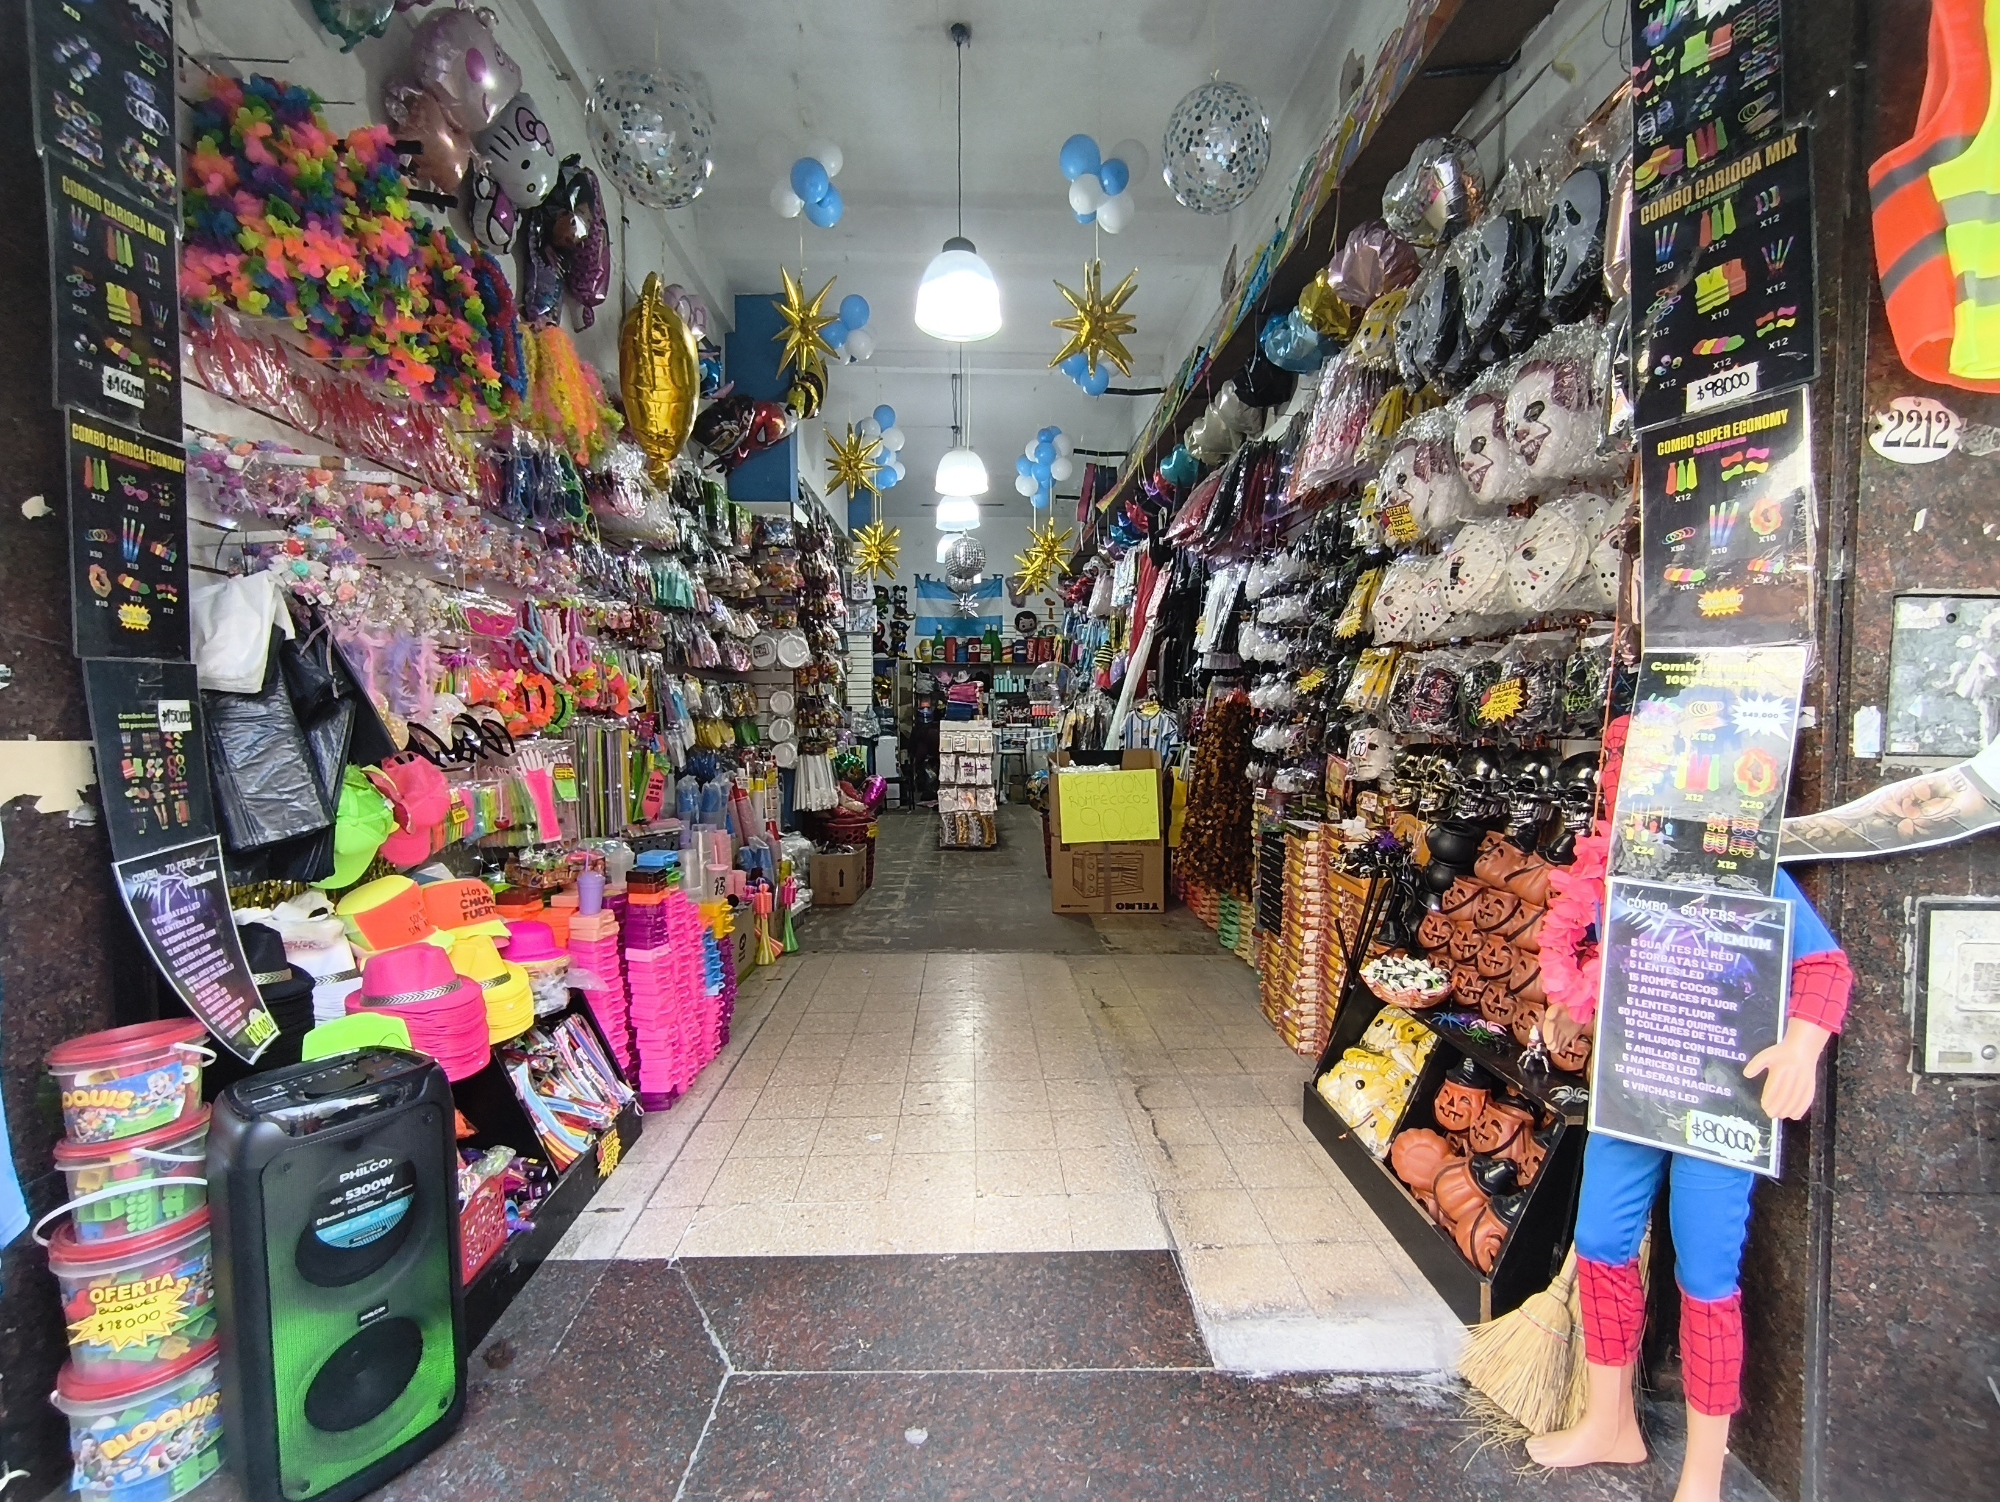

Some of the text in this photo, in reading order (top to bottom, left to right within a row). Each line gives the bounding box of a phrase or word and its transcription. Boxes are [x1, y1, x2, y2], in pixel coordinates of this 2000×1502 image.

[1640, 133, 1798, 226] COMBO CARIOCA MIX
[62, 175, 166, 246] COMBO CARIOCA MIX
[1760, 214, 1780, 228] X12
[1708, 240, 1727, 253] X12
[1655, 262, 1674, 275] X20
[1766, 282, 1786, 296] X12
[1710, 308, 1730, 321] X10
[1652, 328, 1670, 340] X12
[1768, 338, 1788, 350] X12
[1712, 358, 1732, 370] X12
[1659, 378, 1676, 390] X12
[1658, 434, 1694, 456] COMBO
[1696, 424, 1731, 446] SUPER
[1733, 408, 1788, 437] ECONOMY
[1883, 409, 1951, 449] 2212
[72, 423, 186, 474] COMBO CARIOCA ECONOMY
[1675, 493, 1692, 502] X12
[1386, 505, 1410, 516] OFERTA
[1758, 534, 1776, 543] X10
[1712, 546, 1728, 555] X10
[1490, 678, 1520, 694] OFERTA
[1666, 675, 1688, 685] 100
[1740, 800, 1764, 810] X20
[1632, 846, 1654, 856] X24
[1718, 860, 1737, 870] X12
[132, 868, 158, 884] COMBO
[462, 906, 496, 920] FUERT
[1627, 898, 1736, 922] COMBO 60 PERS
[1640, 939, 1691, 955] GUANTES
[1694, 948, 1708, 958] DE
[1711, 950, 1734, 961] RED
[1705, 931, 1772, 950] PREMIUM
[1638, 962, 1681, 976] LENTES
[1683, 969, 1704, 980] LED
[1639, 951, 1698, 968] CORBATAS
[1701, 961, 1724, 972] LED
[1629, 972, 1718, 996] 15 ROMPE COCOS
[1628, 984, 1738, 1011] 12 ANTIFACES FLUOR
[1635, 998, 1677, 1014] LENTES
[1678, 1006, 1715, 1021] FLUOR
[1626, 1017, 1736, 1046] 10 COLLARES DE TELA
[1632, 1009, 1685, 1026] PULSERAS
[1686, 1020, 1737, 1036] QUIMICAS
[1624, 1029, 1746, 1062] 12 PILUSOS CON BRILLO
[1634, 1044, 1678, 1060] ANILLOS
[1680, 1054, 1700, 1066] LED
[1630, 1055, 1675, 1071] NARICES
[1676, 1064, 1697, 1076] LED
[1614, 1064, 1731, 1096] 12 PULSERAS MAGICAS
[1631, 1082, 1676, 1099] VINCHAS
[1678, 1092, 1699, 1104] LED
[340, 1159, 390, 1183] PHILCO
[345, 1174, 394, 1200] 5300W
[89, 1273, 174, 1304] OFERTA
[99, 1296, 158, 1315] BLOQUES
[100, 1391, 221, 1460] BLOQUIS
